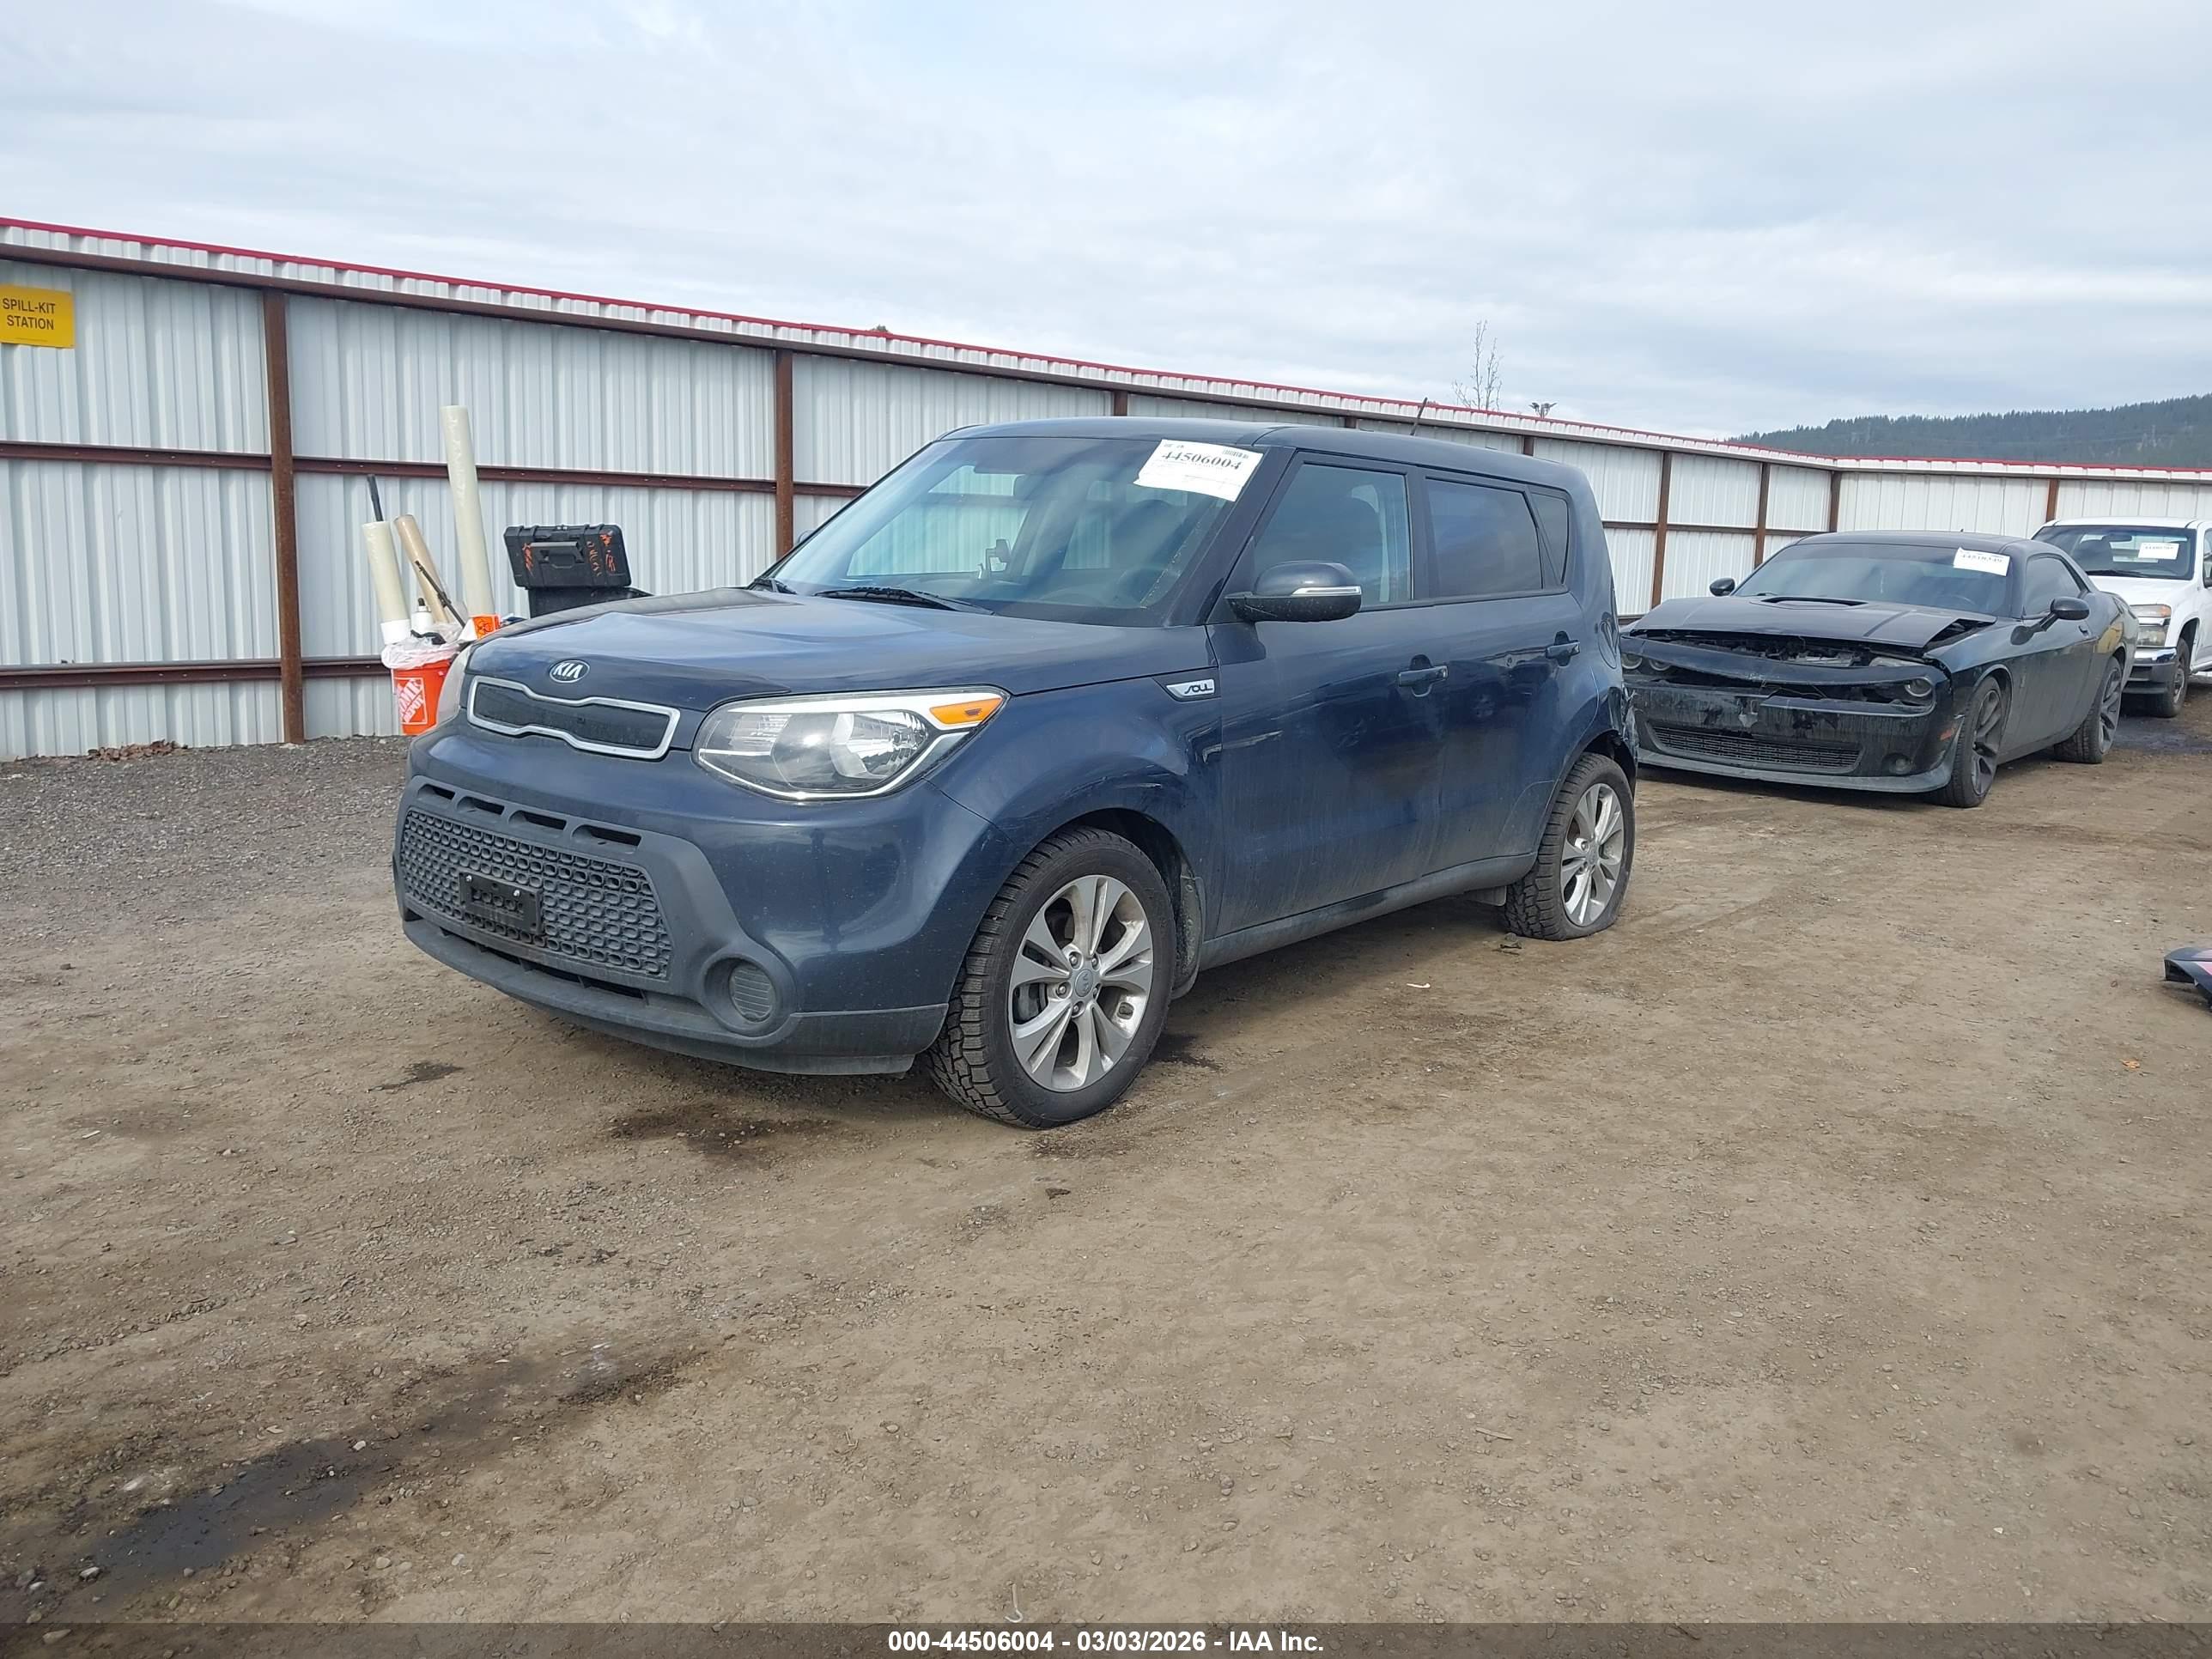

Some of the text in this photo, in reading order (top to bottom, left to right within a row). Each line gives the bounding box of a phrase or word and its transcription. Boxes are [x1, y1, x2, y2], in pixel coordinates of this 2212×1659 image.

[3, 298, 56, 314] SPILL-KIT
[7, 314, 54, 331] STATION
[1162, 450, 1243, 471] 44506004
[552, 662, 584, 679] KIA
